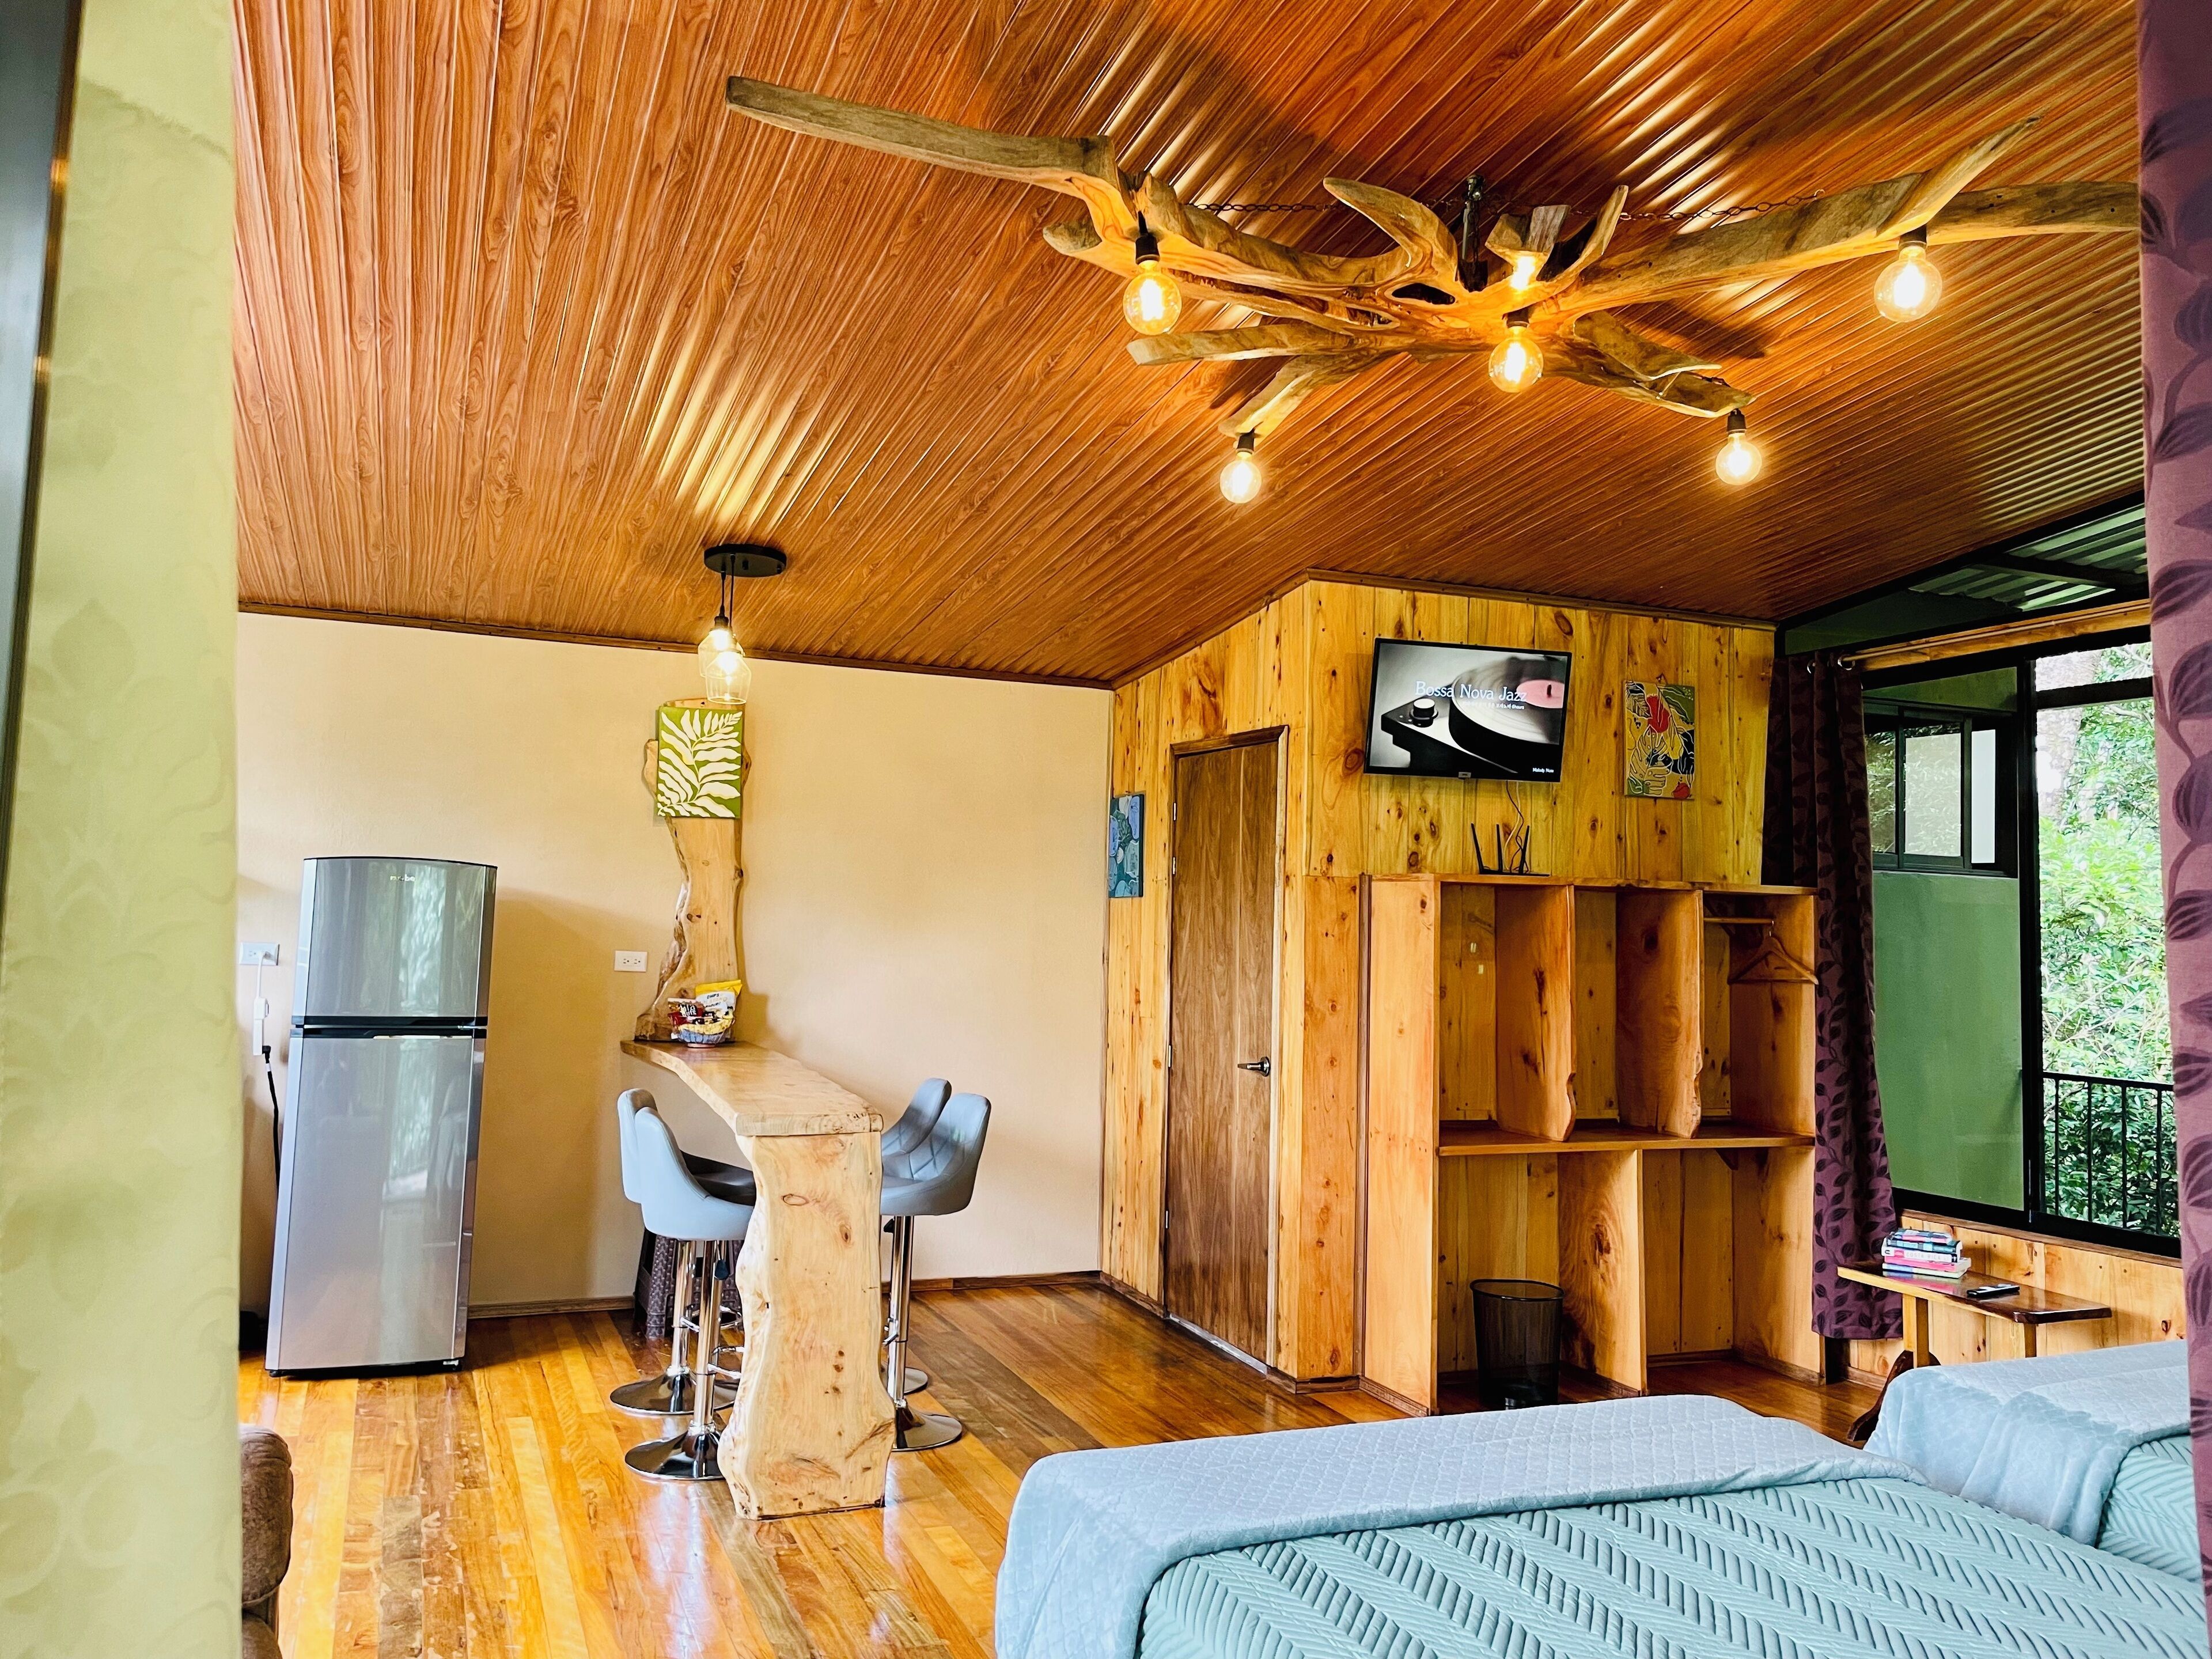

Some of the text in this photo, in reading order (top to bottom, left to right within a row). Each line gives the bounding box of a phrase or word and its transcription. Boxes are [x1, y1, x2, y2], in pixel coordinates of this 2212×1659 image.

[1415, 680, 1527, 702] Bossa Nova Jazz
